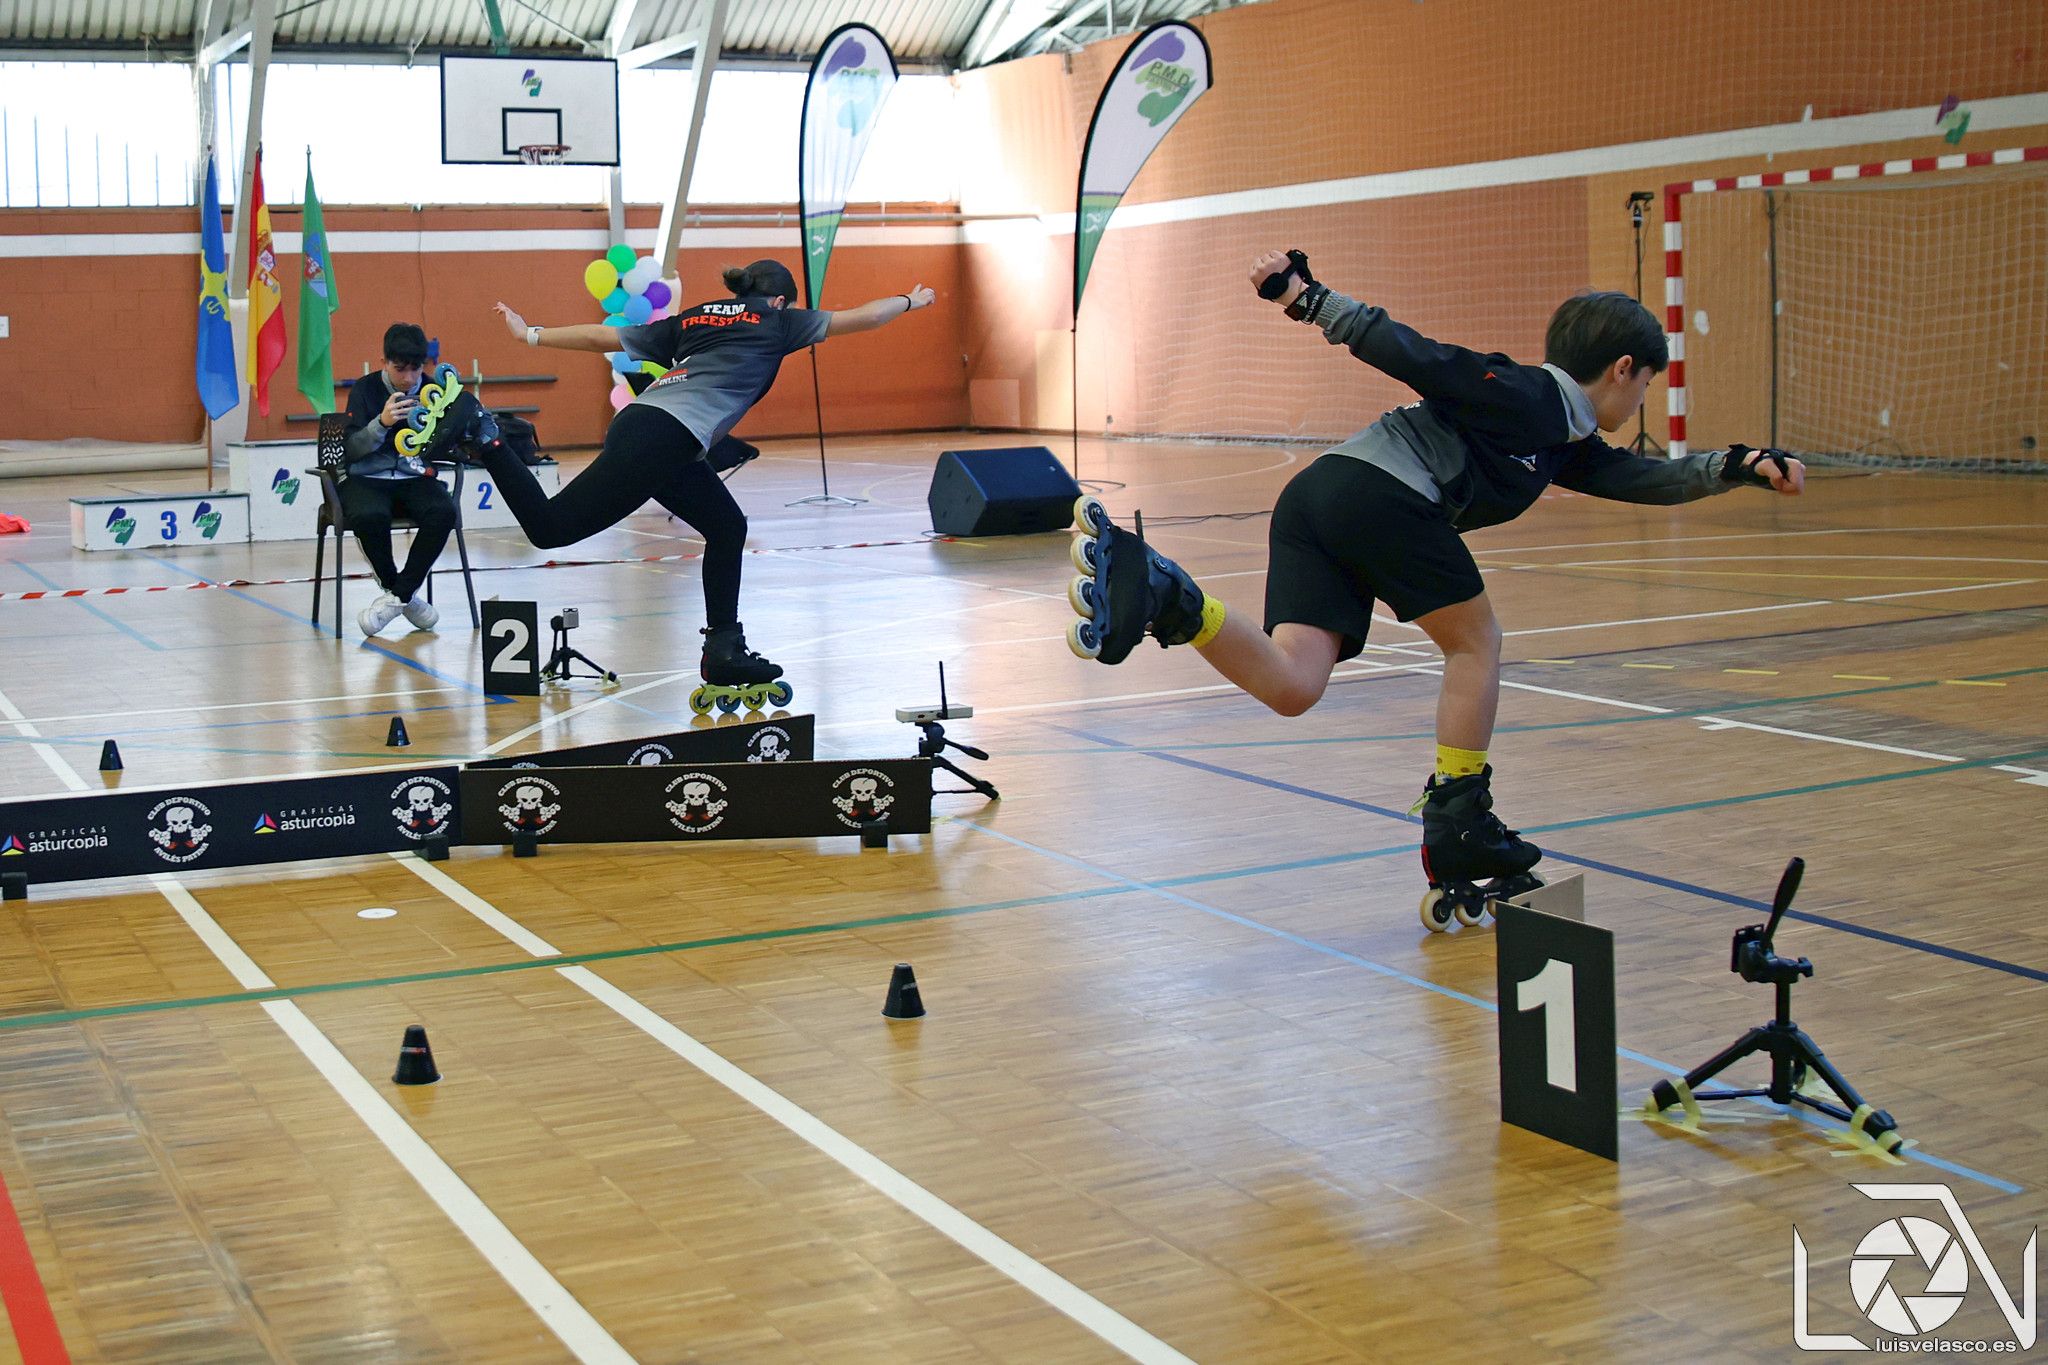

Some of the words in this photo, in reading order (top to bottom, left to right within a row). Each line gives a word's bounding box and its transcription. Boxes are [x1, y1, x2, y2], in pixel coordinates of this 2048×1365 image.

[702, 303, 746, 315] TEAM
[681, 311, 761, 330] FREESTYLE
[477, 481, 493, 510] 2
[160, 510, 178, 540] 3
[490, 618, 531, 673] 2
[626, 748, 642, 765] CLUB
[641, 743, 674, 760] DEPORTIVO
[390, 781, 408, 799] CLUB
[407, 776, 451, 795] DEPORTIVO
[497, 780, 516, 796] CLUB
[515, 776, 560, 796] DEPORTIVO
[664, 776, 684, 793] CLUB
[683, 772, 728, 792] DEPORTIVO
[832, 772, 851, 788] CLUB
[850, 768, 894, 787] DEPORTIVO
[147, 801, 166, 820] CLUB
[165, 796, 211, 816] DEPORTIVO
[280, 804, 354, 818] GRAFICAS
[28, 825, 107, 839] GRAFICAS
[280, 813, 356, 831] asturcopia
[29, 834, 108, 853] asturcopia
[1516, 957, 1578, 1094] 1
